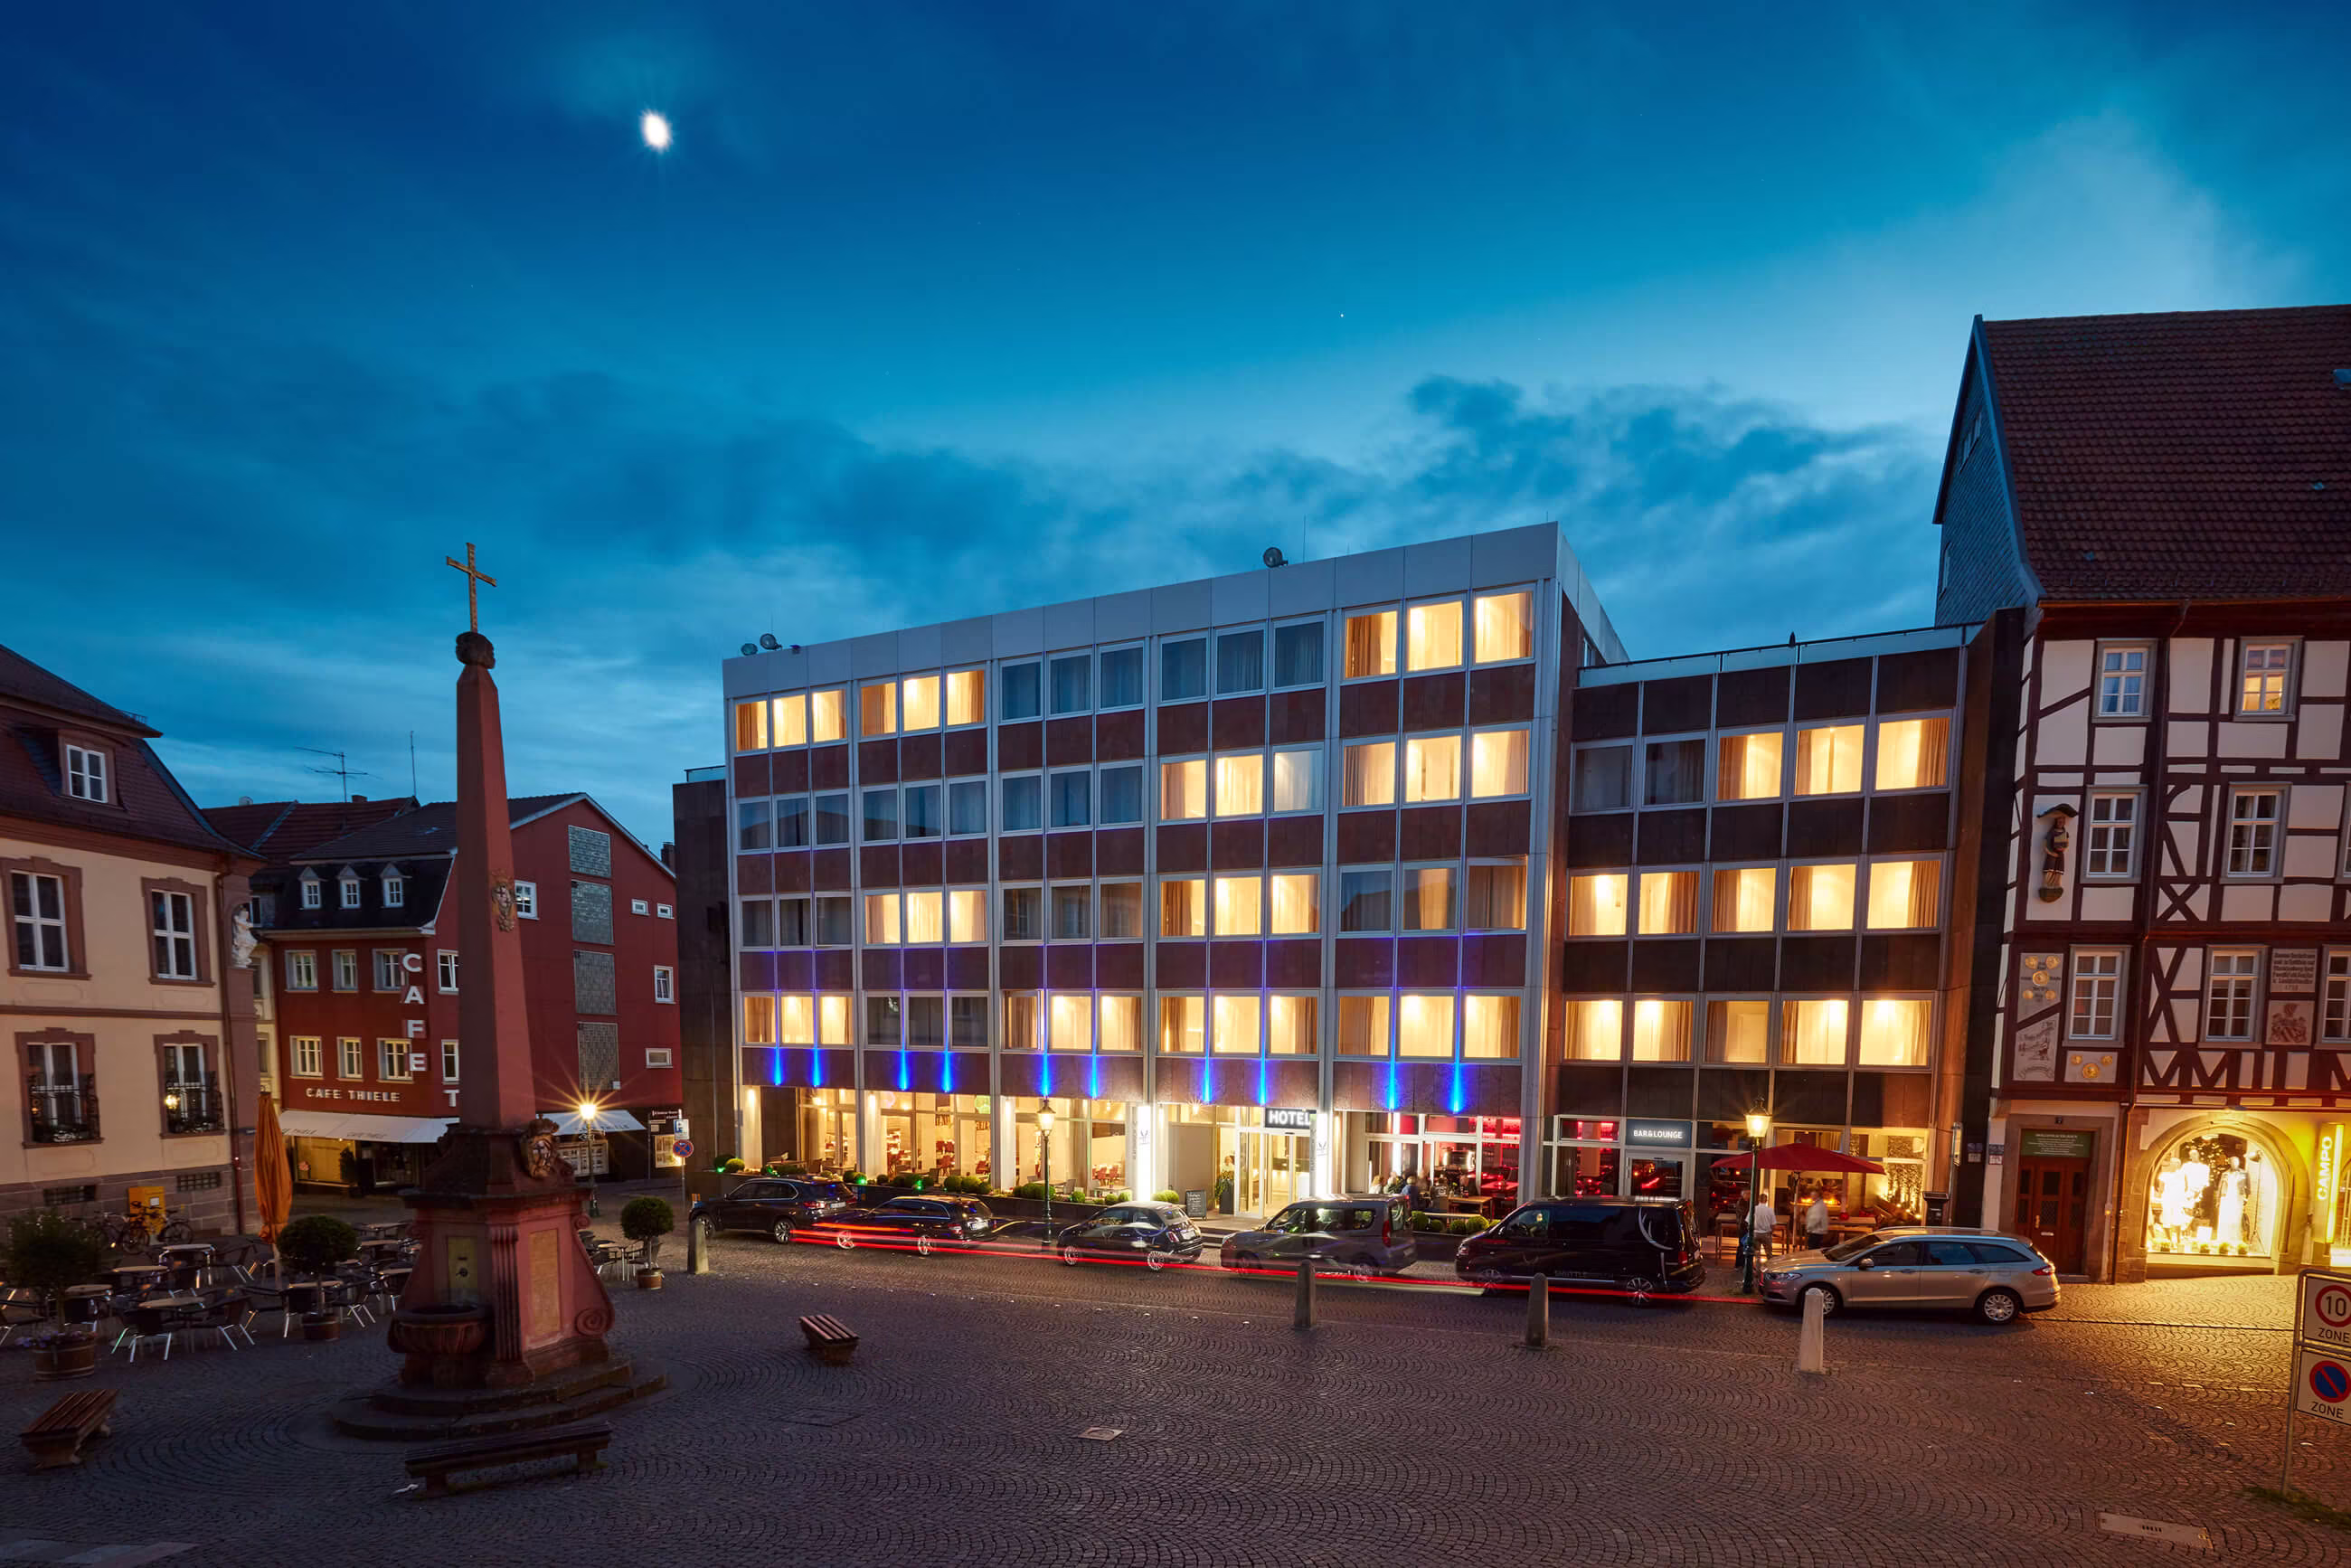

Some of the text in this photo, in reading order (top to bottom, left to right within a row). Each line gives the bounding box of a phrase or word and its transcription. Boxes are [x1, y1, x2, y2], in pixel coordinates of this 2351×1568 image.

[402, 953, 426, 1072] CAFE
[306, 1088, 401, 1102] CAFE THIELE
[1269, 1110, 1311, 1126] HOTEL
[2317, 1136, 2332, 1201] CAMPO
[2326, 1295, 2347, 1318] 10
[2318, 1327, 2351, 1344] ZONE
[2311, 1401, 2345, 1419] ZONE
